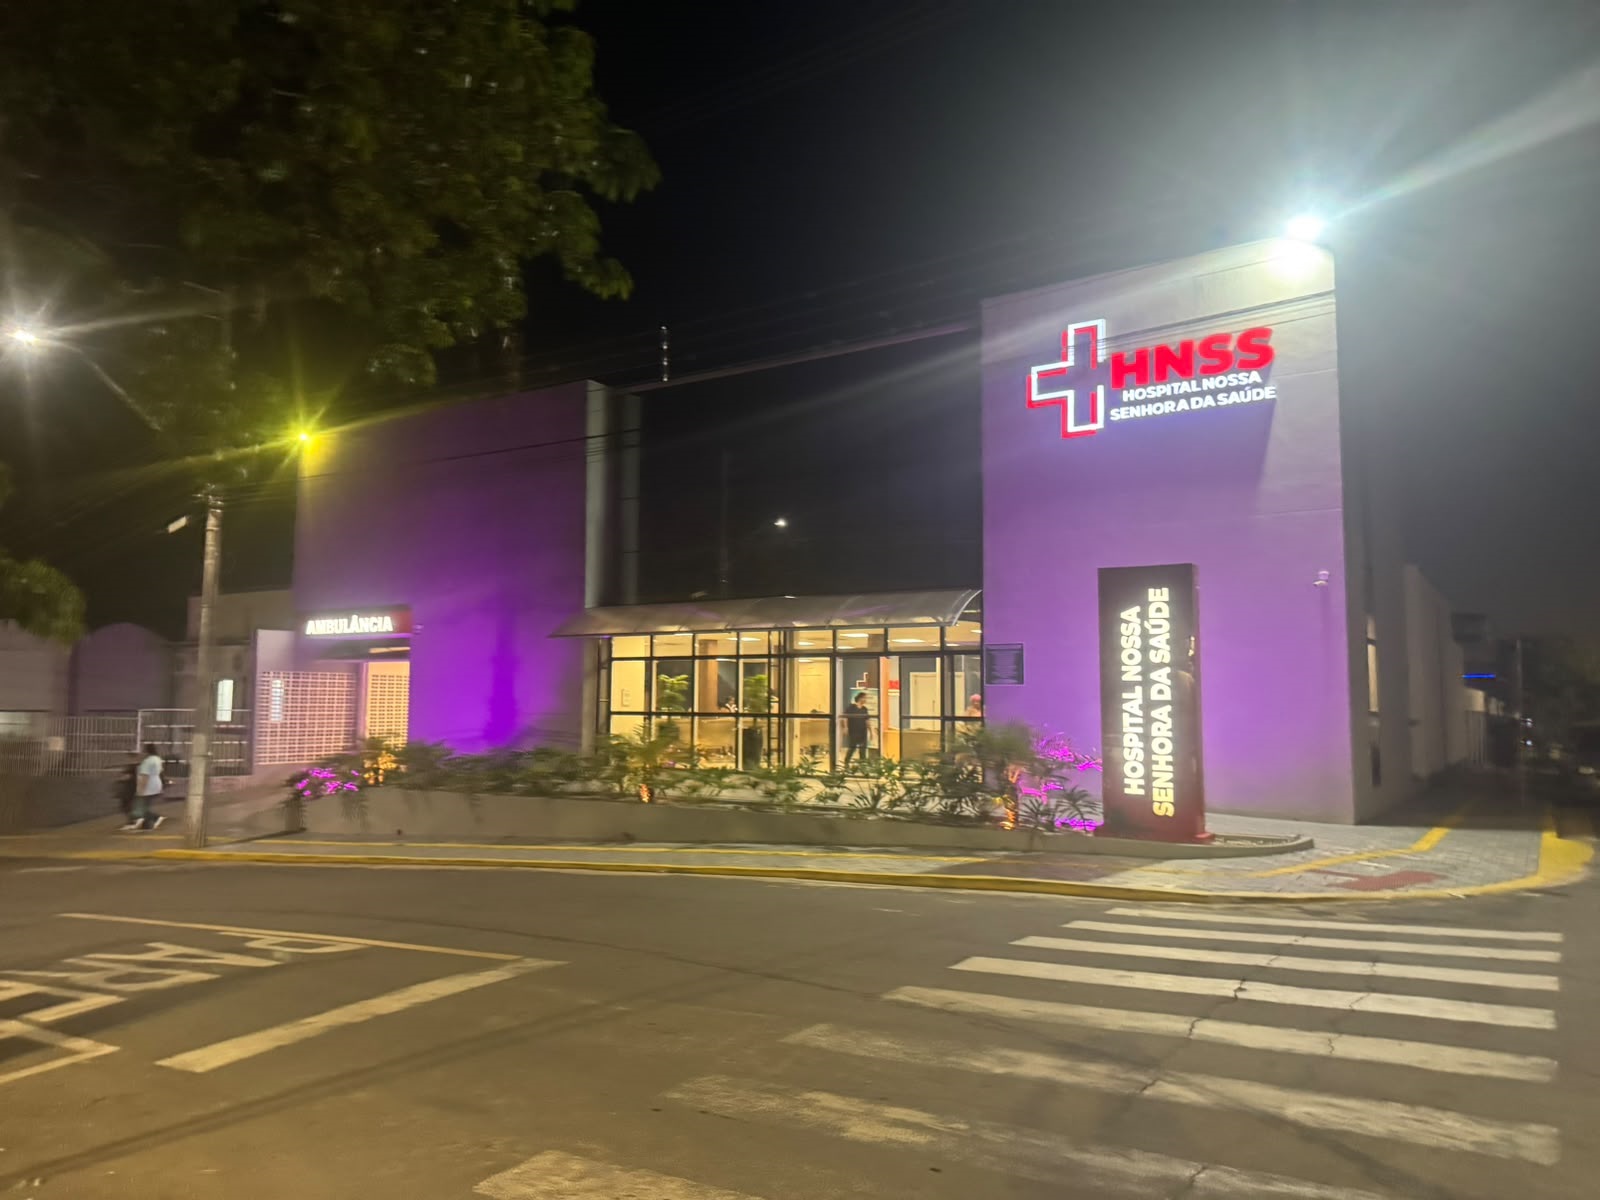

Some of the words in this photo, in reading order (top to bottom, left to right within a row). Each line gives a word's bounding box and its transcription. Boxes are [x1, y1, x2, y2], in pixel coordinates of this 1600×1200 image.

[1111, 327, 1275, 389] HNSS
[1122, 381, 1201, 402] HOSPITAL
[1202, 370, 1262, 392] NOSSA
[1109, 396, 1189, 421] SENHORA
[1190, 394, 1216, 411] DA
[1217, 385, 1277, 406] SAÚDE
[305, 614, 394, 635] AMBULÂNCIA
[1120, 605, 1143, 681] NOSSA
[1144, 587, 1171, 663] SAÚDE
[1150, 666, 1172, 700] DA
[1122, 685, 1145, 795] HOSPITAL
[1151, 704, 1175, 817] SENHORA
